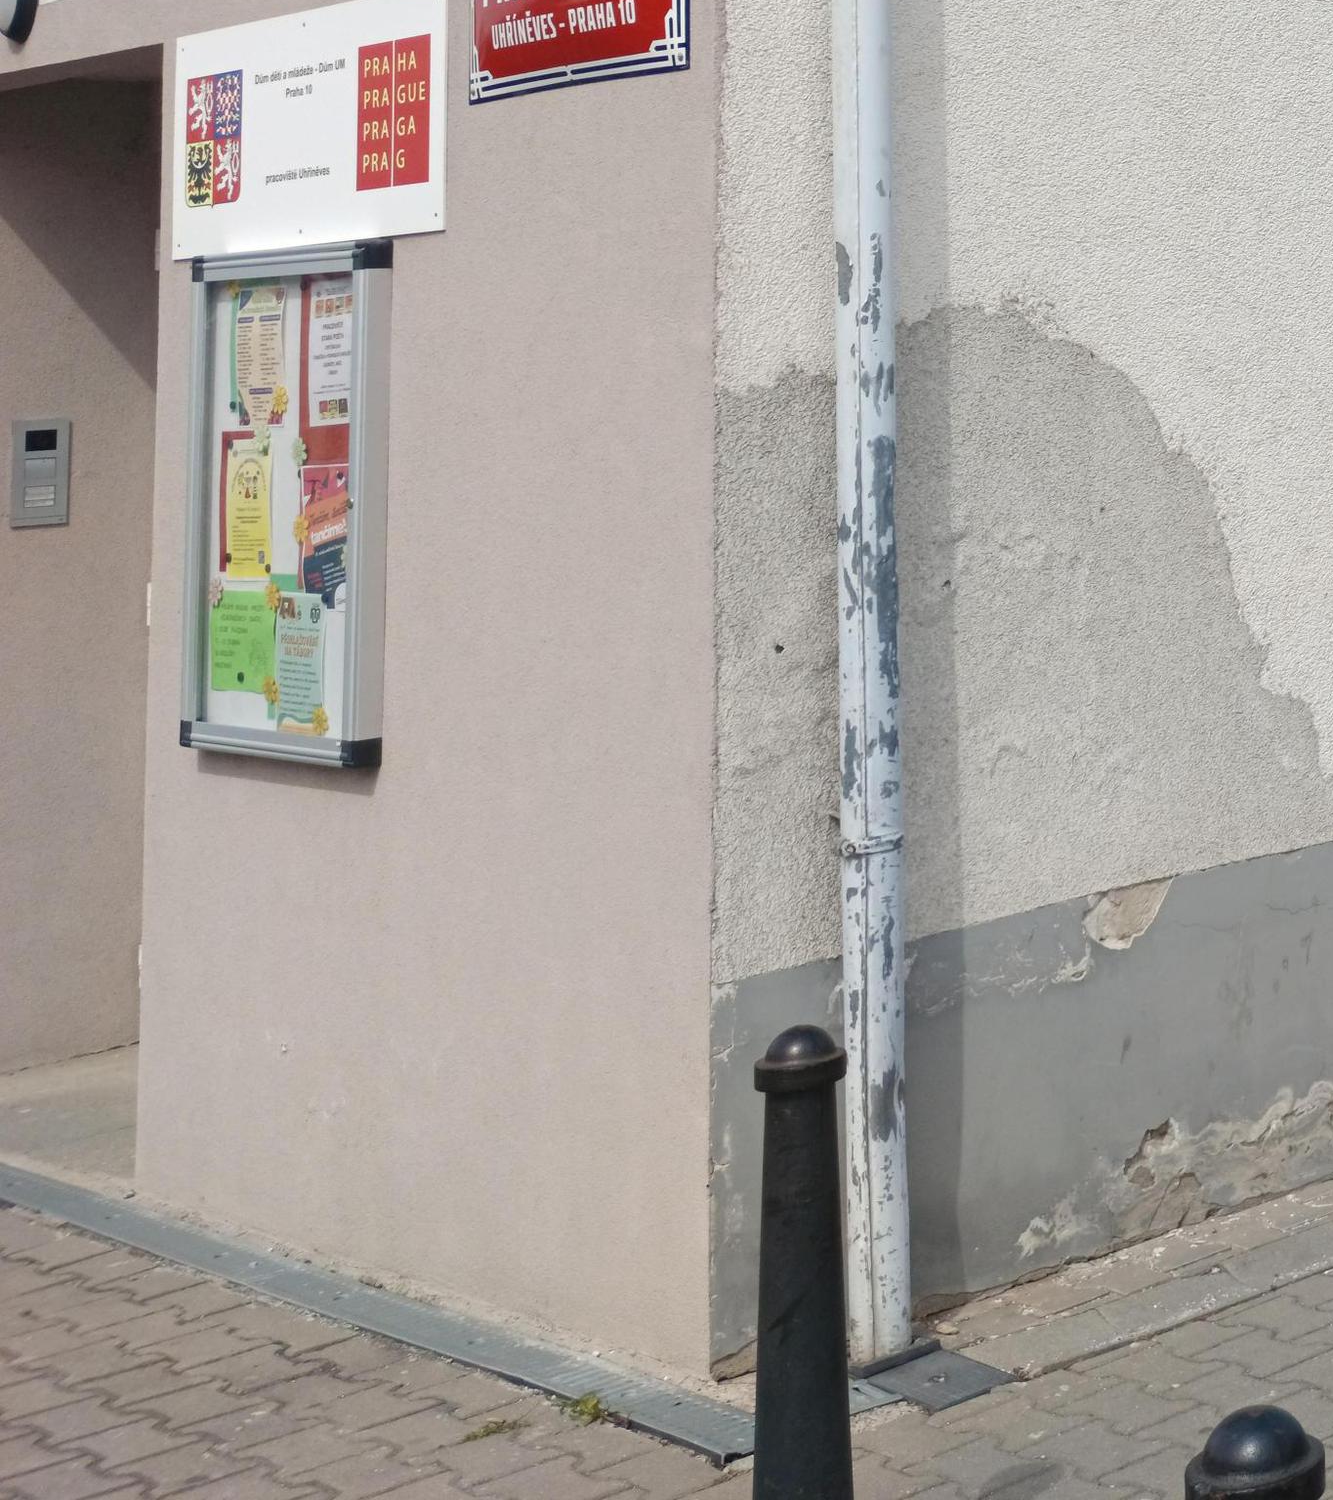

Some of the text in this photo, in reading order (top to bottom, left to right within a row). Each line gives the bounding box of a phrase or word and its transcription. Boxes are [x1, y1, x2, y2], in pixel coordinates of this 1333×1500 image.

[491, 11, 557, 50] UHŘÍNĚVES
[568, 1, 616, 35] PRAHA
[285, 84, 313, 98] Praha 10
